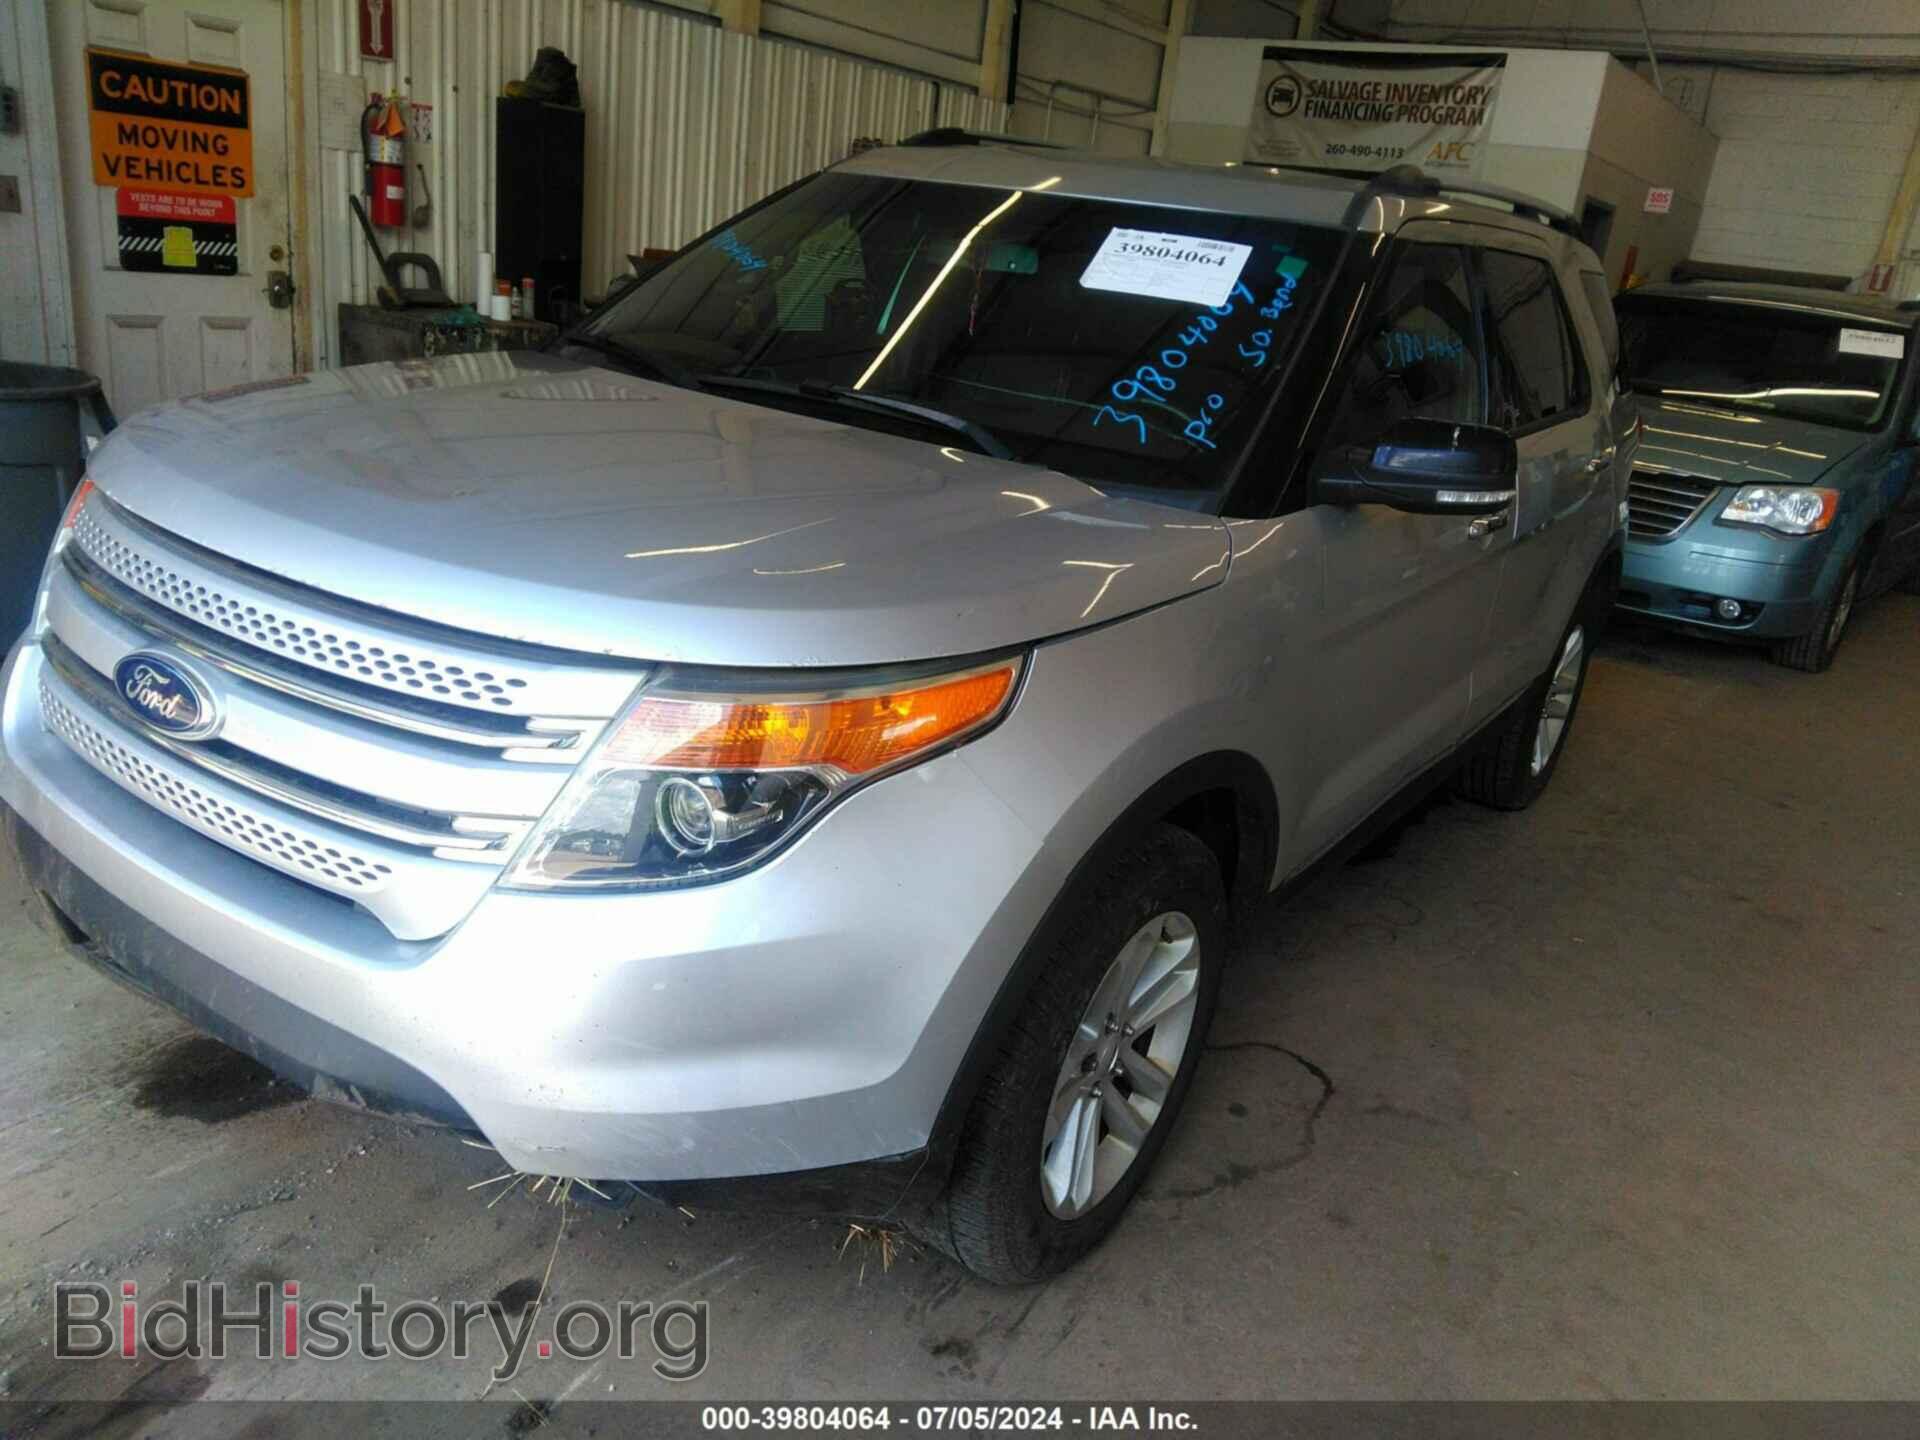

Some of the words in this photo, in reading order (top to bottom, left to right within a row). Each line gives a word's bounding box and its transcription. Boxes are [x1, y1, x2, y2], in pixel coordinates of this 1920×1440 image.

[101, 70, 241, 114] CAUTION
[1303, 79, 1382, 101] SALVAGE
[1386, 83, 1494, 106] INVENTORY
[1303, 100, 1393, 123] FINANCING
[1395, 105, 1486, 127] PROGRAM
[117, 121, 229, 156] MOVING
[1324, 143, 1405, 160] 260-490-4113
[1427, 142, 1475, 162] AFC
[101, 152, 246, 189] VEHICLES
[1113, 242, 1227, 267] 39804064
[126, 664, 181, 718] Ford
